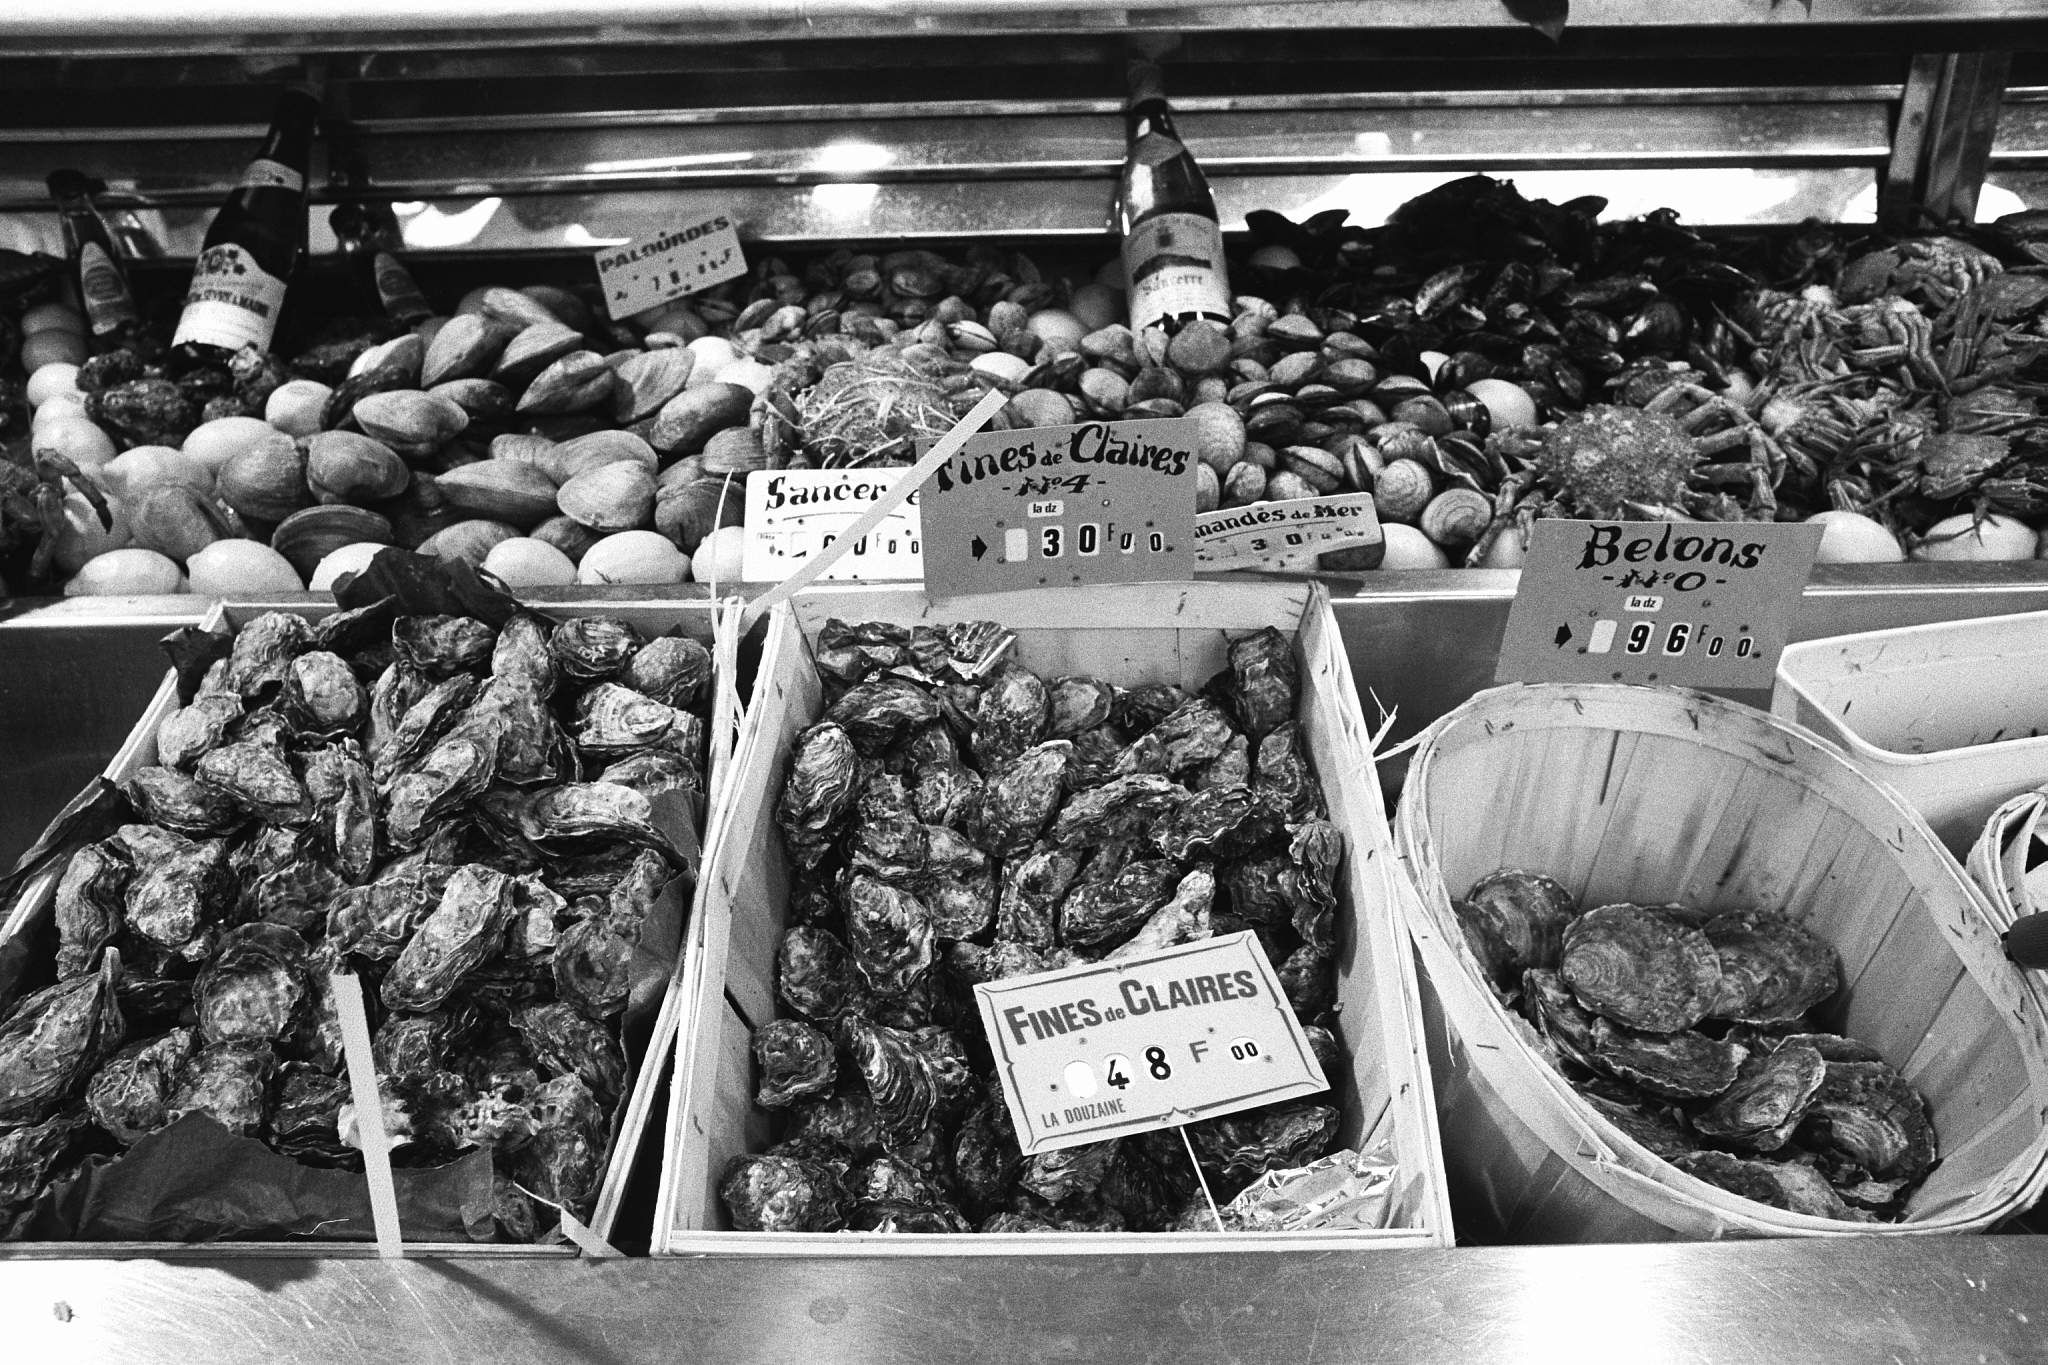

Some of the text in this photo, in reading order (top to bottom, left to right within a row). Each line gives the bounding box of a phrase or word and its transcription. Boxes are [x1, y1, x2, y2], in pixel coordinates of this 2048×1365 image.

[600, 216, 729, 273] PALOURDES
[1040, 450, 1063, 466] de
[1066, 424, 1190, 476] Claires
[766, 476, 920, 511] Sancere
[1033, 502, 1058, 514] la dz
[1195, 504, 1362, 538] mandes de Mer
[1576, 523, 1766, 570] Belons
[1630, 596, 1655, 608] la dz
[1004, 969, 1258, 1045] FINES de CLAIRES
[1189, 1040, 1209, 1063] F
[1230, 1041, 1259, 1061] 00
[1041, 1098, 1127, 1128] LA DOUZAINE
